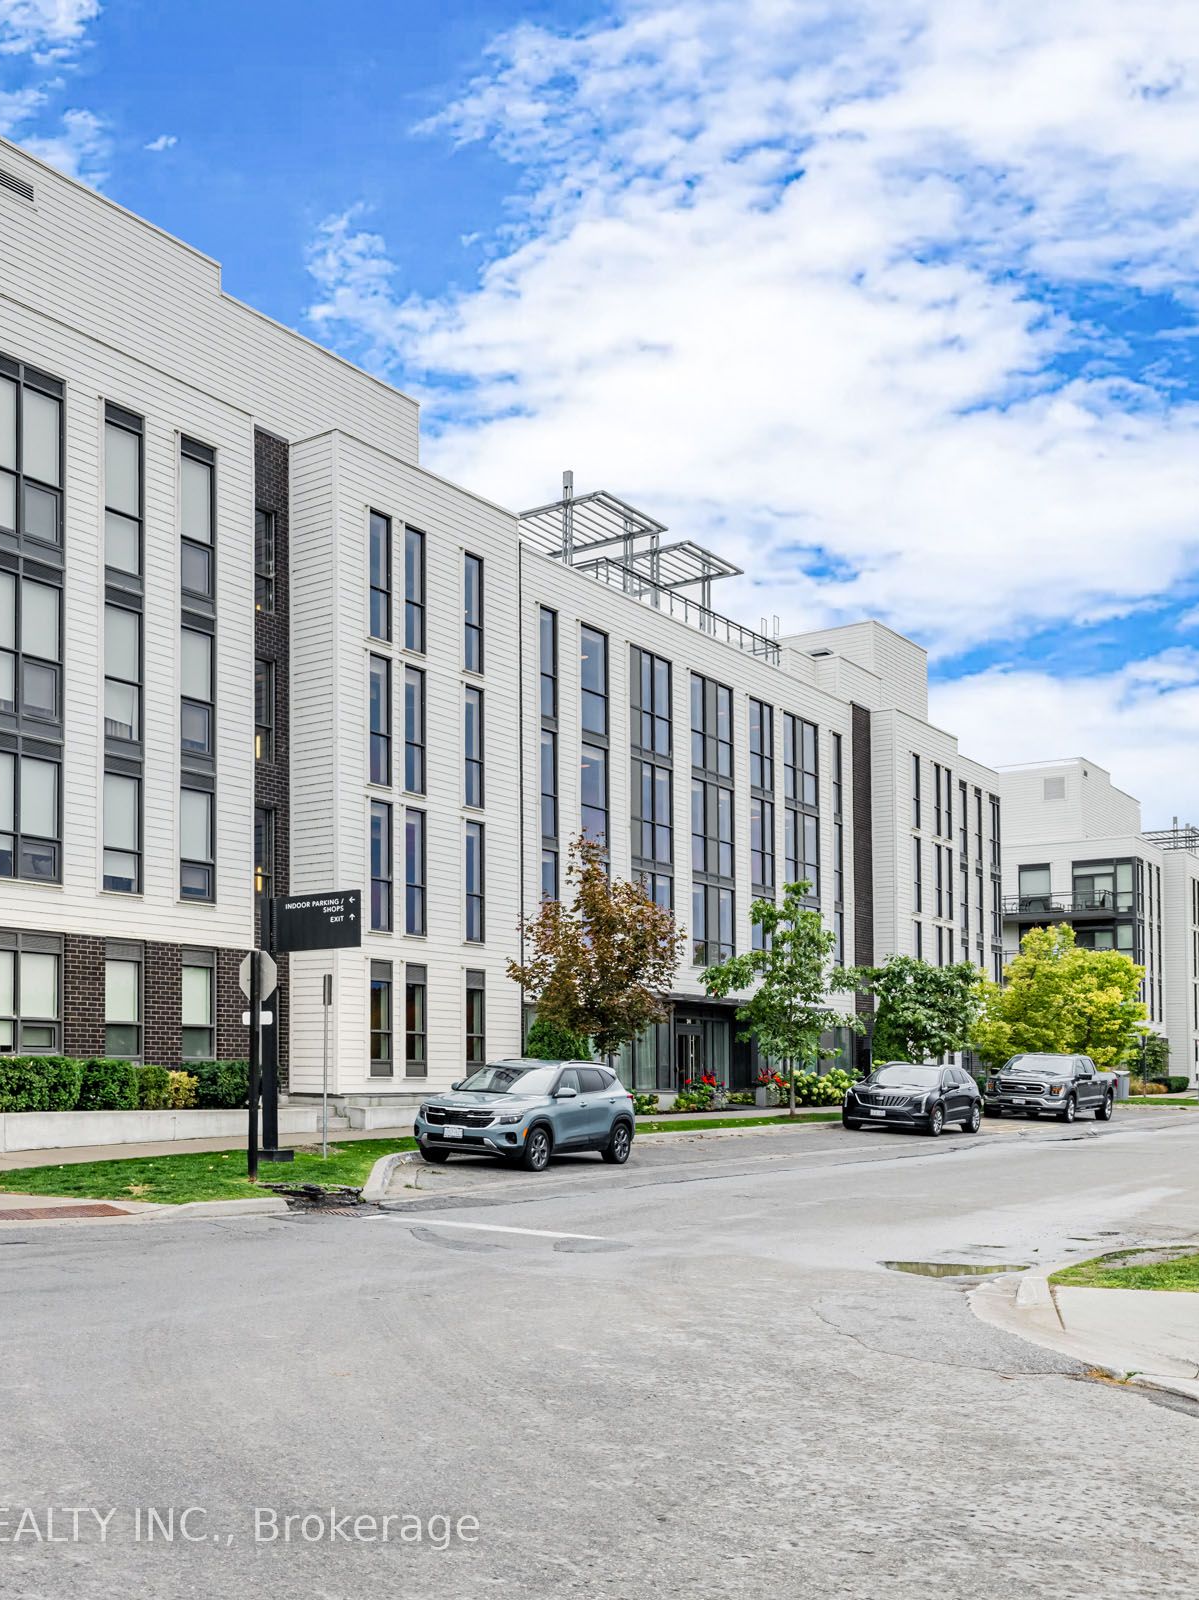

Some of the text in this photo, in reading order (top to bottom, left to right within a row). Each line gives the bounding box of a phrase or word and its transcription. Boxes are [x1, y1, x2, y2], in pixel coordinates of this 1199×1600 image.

[285, 902, 310, 910] INDOOR
[312, 899, 339, 907] PARKING
[323, 905, 344, 913] SHOPS
[330, 915, 344, 923] EXIT
